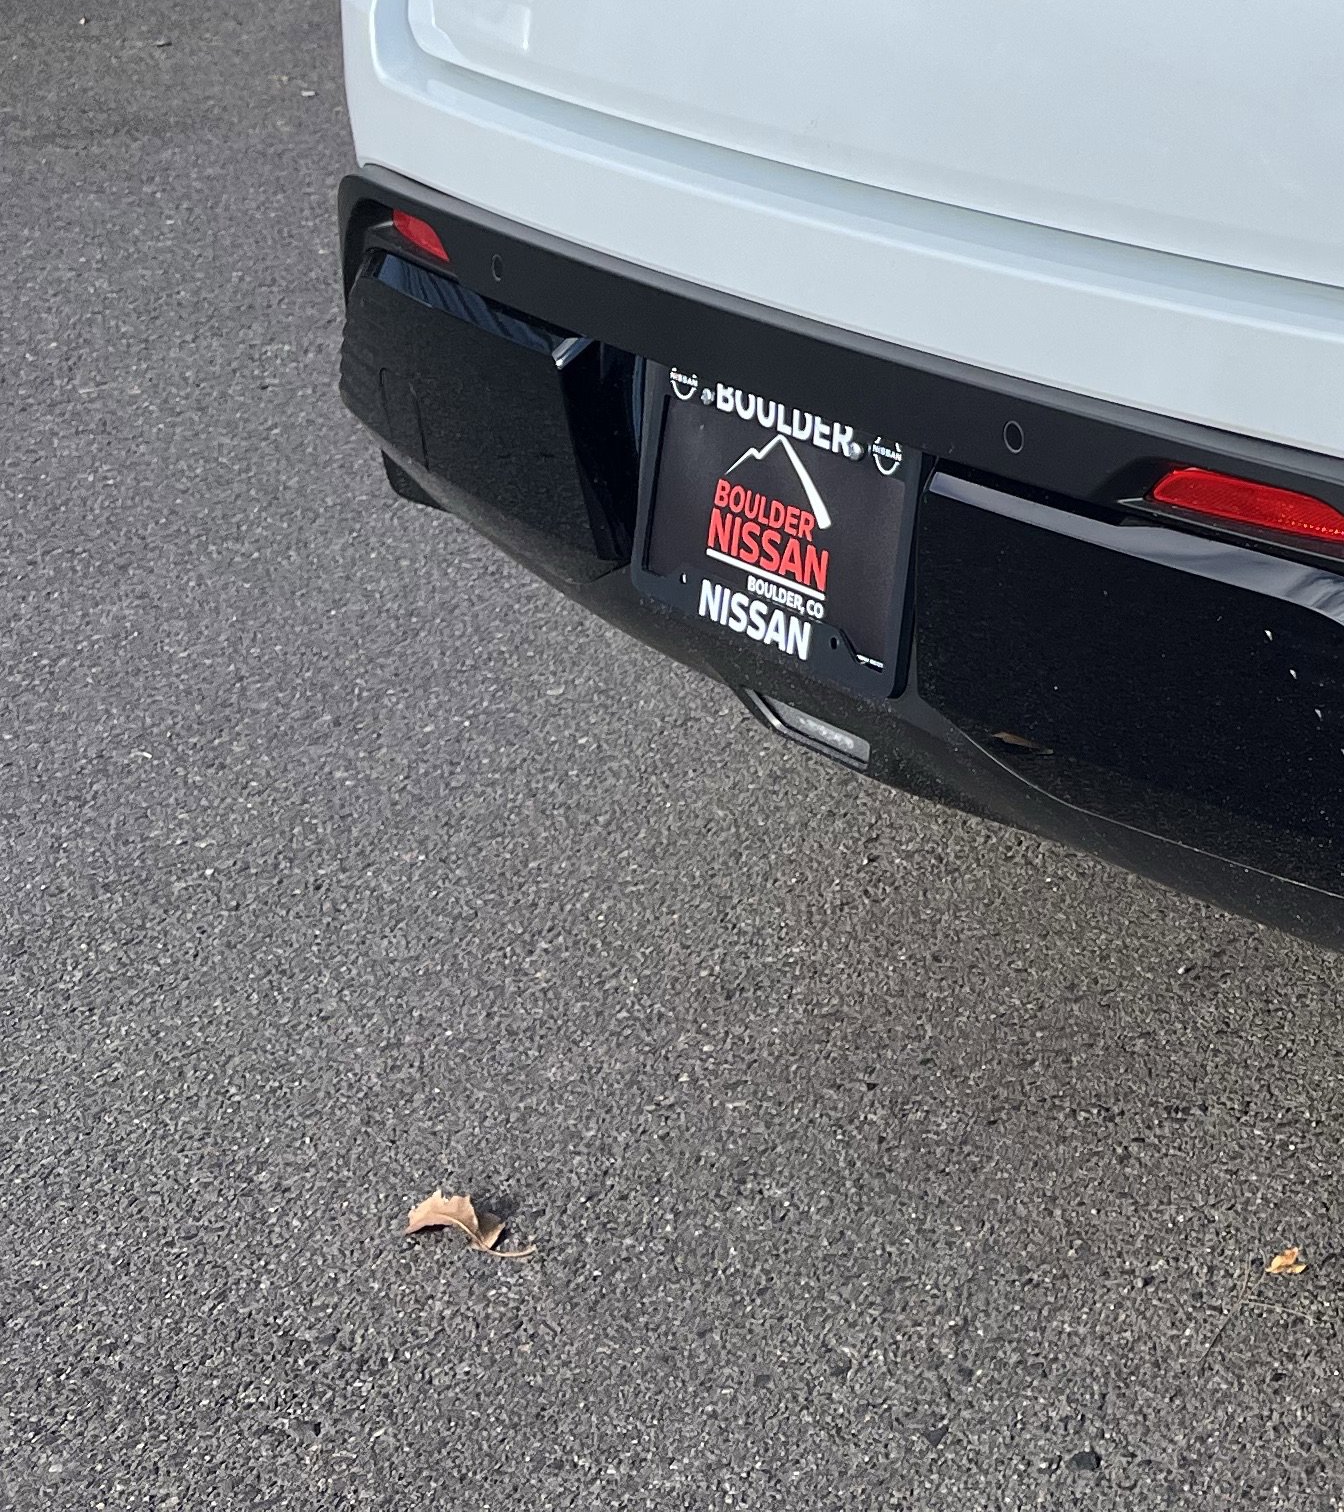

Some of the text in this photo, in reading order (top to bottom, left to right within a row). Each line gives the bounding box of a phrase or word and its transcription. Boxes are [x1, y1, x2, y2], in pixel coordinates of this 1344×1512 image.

[716, 383, 854, 458] BOULDER
[714, 478, 815, 542] BOULDER
[707, 508, 829, 592] NISSAN
[698, 579, 812, 661] NISSAN
[747, 574, 825, 619] BOULDER, CO
